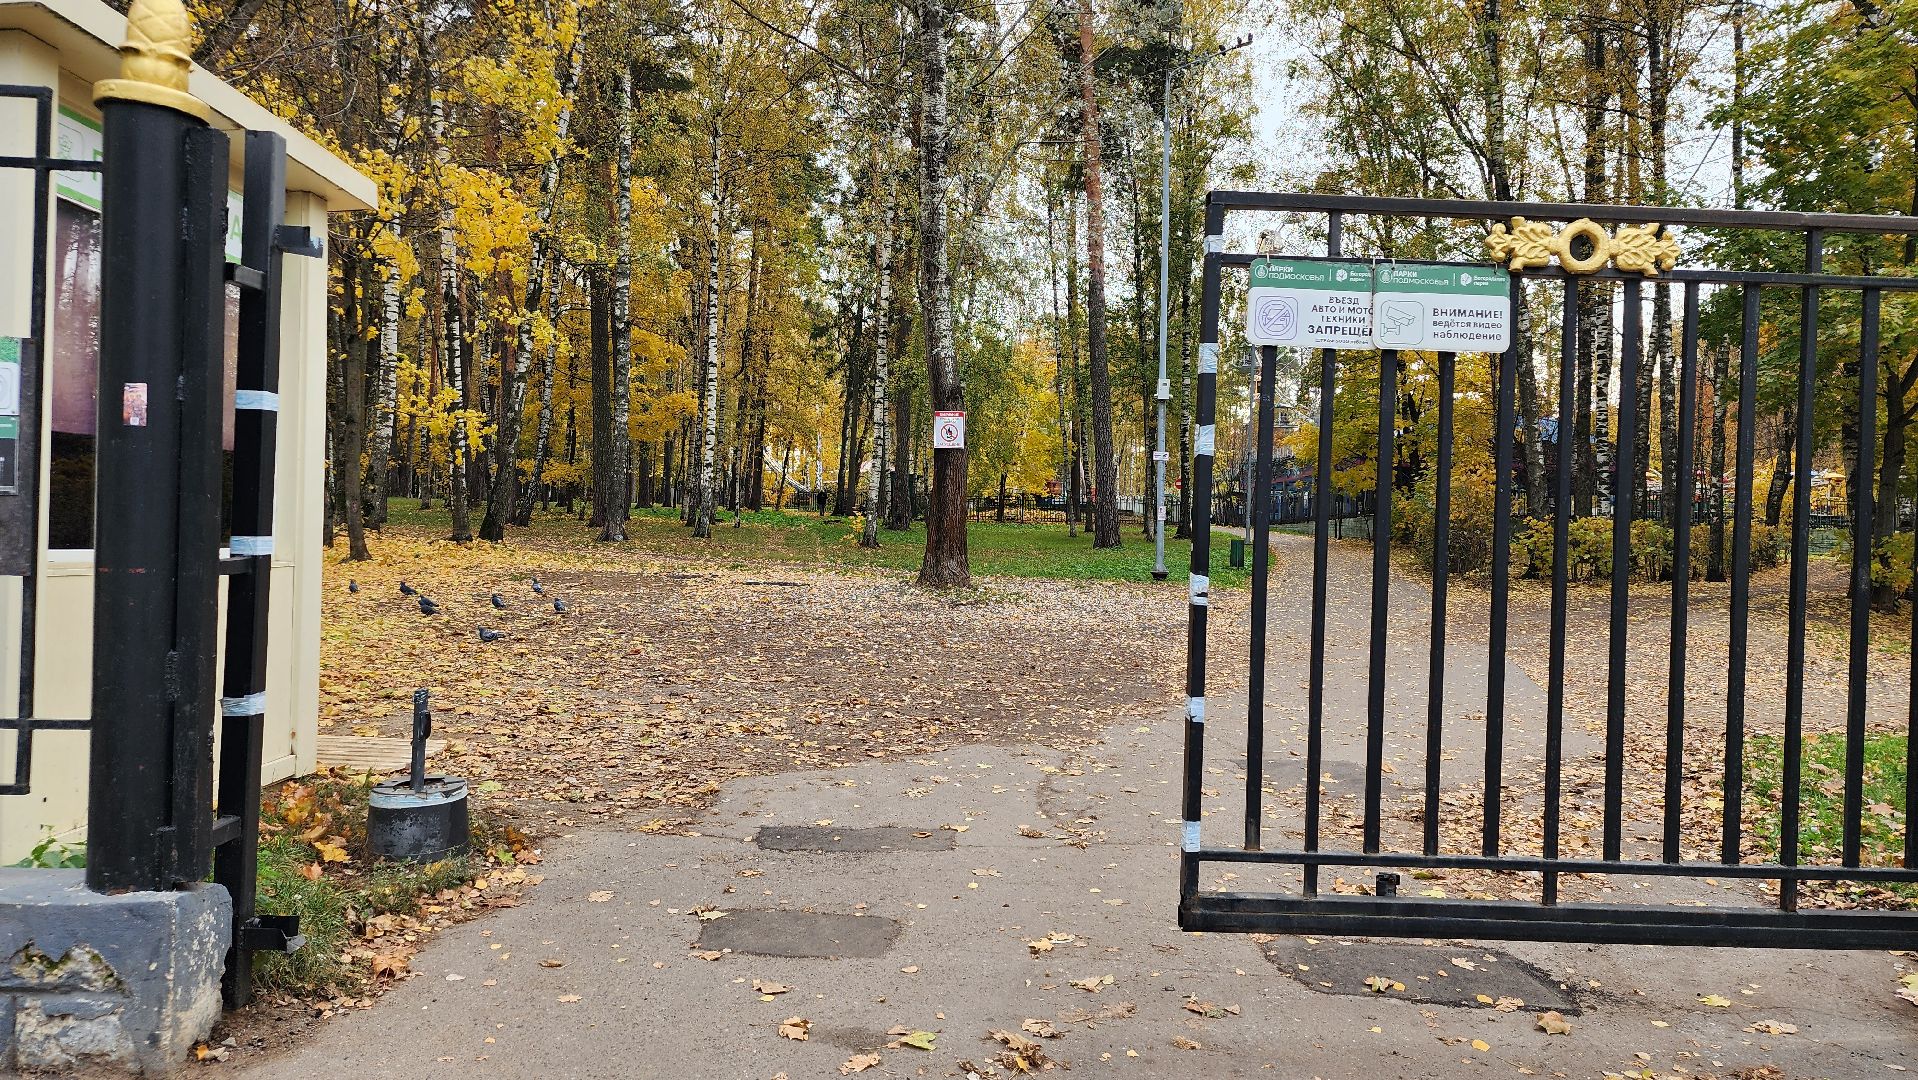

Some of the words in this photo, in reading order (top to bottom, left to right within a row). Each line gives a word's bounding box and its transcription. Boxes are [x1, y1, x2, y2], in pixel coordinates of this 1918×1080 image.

[1269, 264, 1294, 273] ПАРКИ
[1268, 272, 1325, 282] ПОДМОСКОВЬЯ
[1393, 270, 1418, 278] ПАРКИ
[1392, 277, 1449, 286] ПОДМОСКОВЬЯ
[1328, 296, 1360, 306] ВЪЕЗД
[1311, 304, 1337, 313] АВТО
[1338, 305, 1345, 314] И
[1432, 307, 1503, 319] ВНИМАНИЕ!
[1321, 315, 1366, 324] ТЕХНИКИ
[1432, 318, 1472, 329] ведётся
[1473, 321, 1503, 330] видео
[1433, 329, 1502, 341] наблюдение
